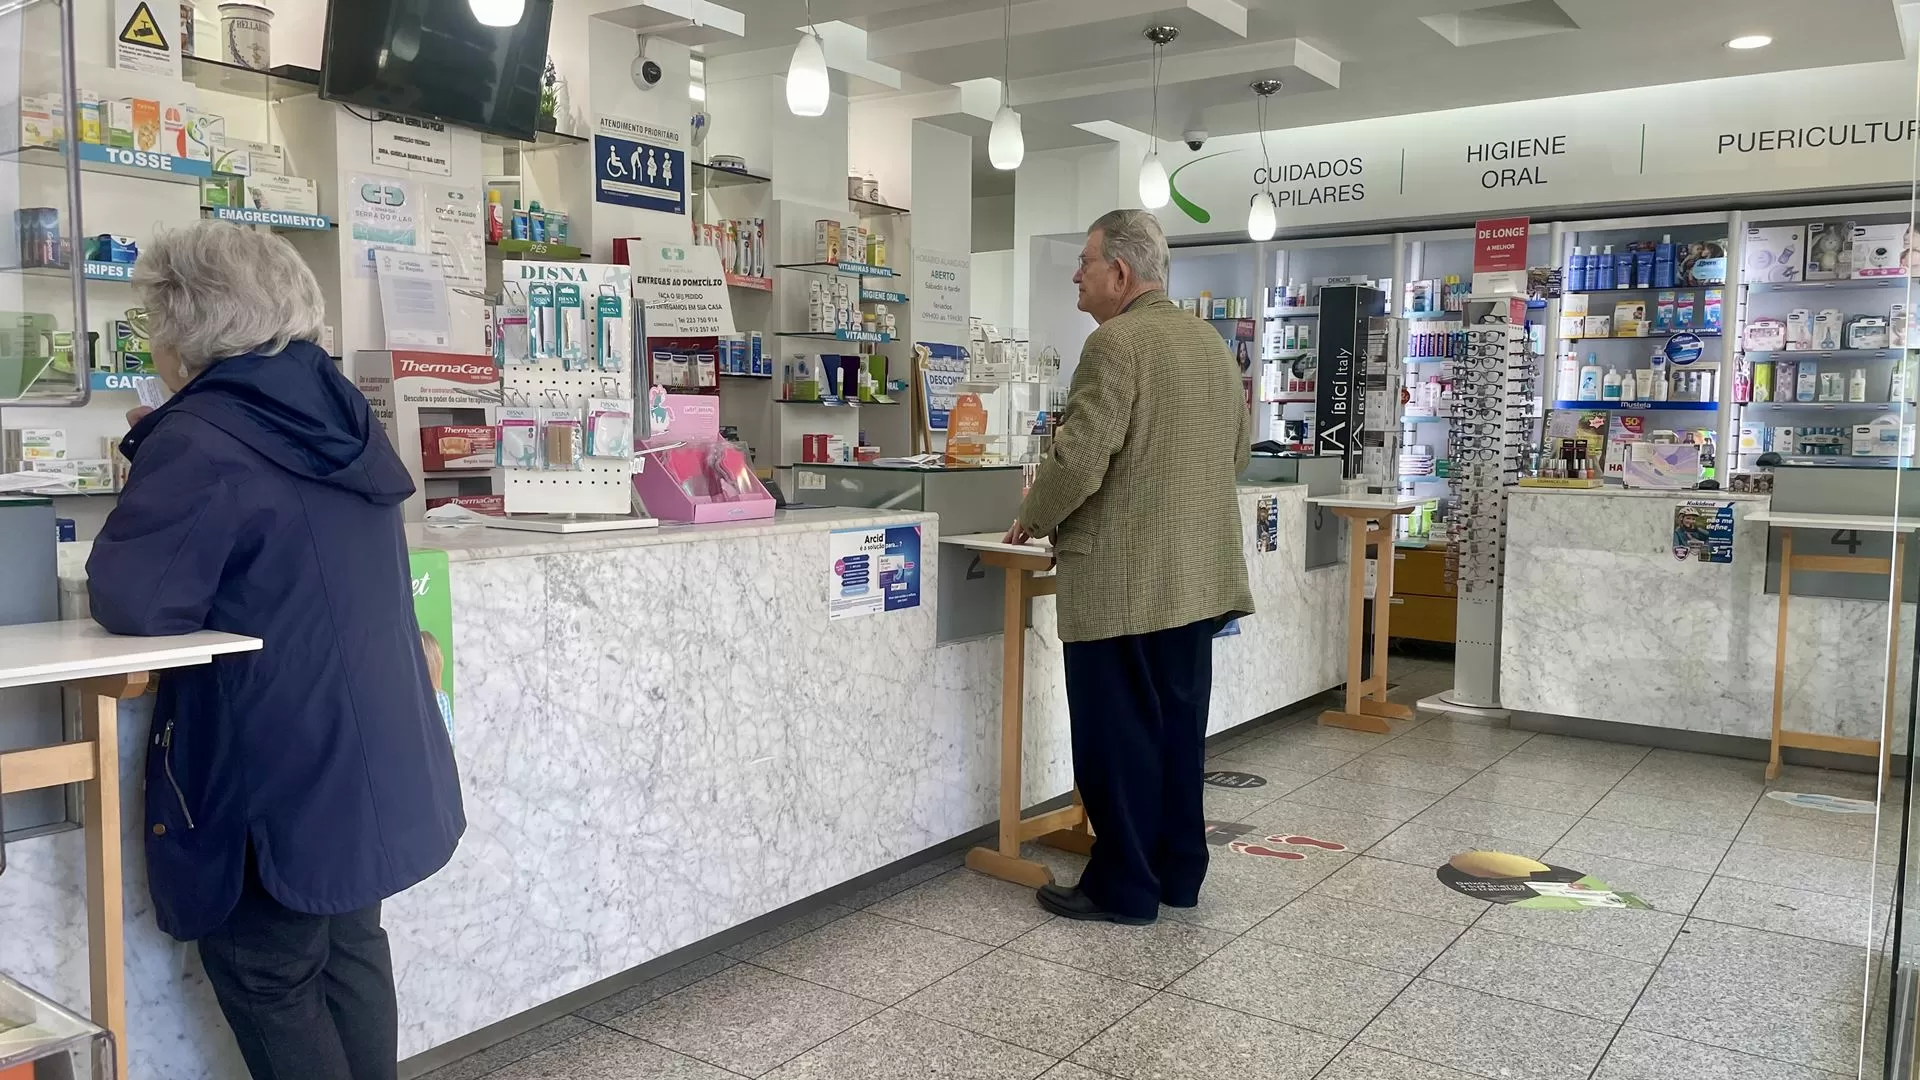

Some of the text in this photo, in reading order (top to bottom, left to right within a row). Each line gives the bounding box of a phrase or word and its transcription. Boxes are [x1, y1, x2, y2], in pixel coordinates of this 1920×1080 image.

[601, 118, 679, 141] ATENDIMENTO PRIORITÁRIO
[1467, 135, 1567, 163] HIGIENE
[106, 148, 171, 170] TOSSE
[1254, 157, 1363, 185] CUIDADOS
[1481, 166, 1547, 189] ORAL
[220, 209, 325, 227] EMAGRECIMENTO
[1479, 227, 1525, 239] DE LONGE
[530, 244, 548, 254] PÉS
[521, 265, 588, 282] DISNA
[838, 263, 892, 276] VITAMINAS INFANTIL
[931, 270, 955, 281] ABERTO
[637, 276, 670, 286] ENTREGAS
[683, 276, 722, 286] DOMICÍLIO
[863, 291, 899, 301] HIGIENE ORAL
[845, 331, 882, 341] VITAMINAS
[400, 360, 493, 375] ThermaCare
[1336, 348, 1352, 375] Italy
[433, 395, 447, 404] poder
[864, 534, 884, 543] Arcid
[1831, 529, 1862, 554] 4
[1711, 546, 1719, 554] 3
[966, 555, 985, 580] 2
